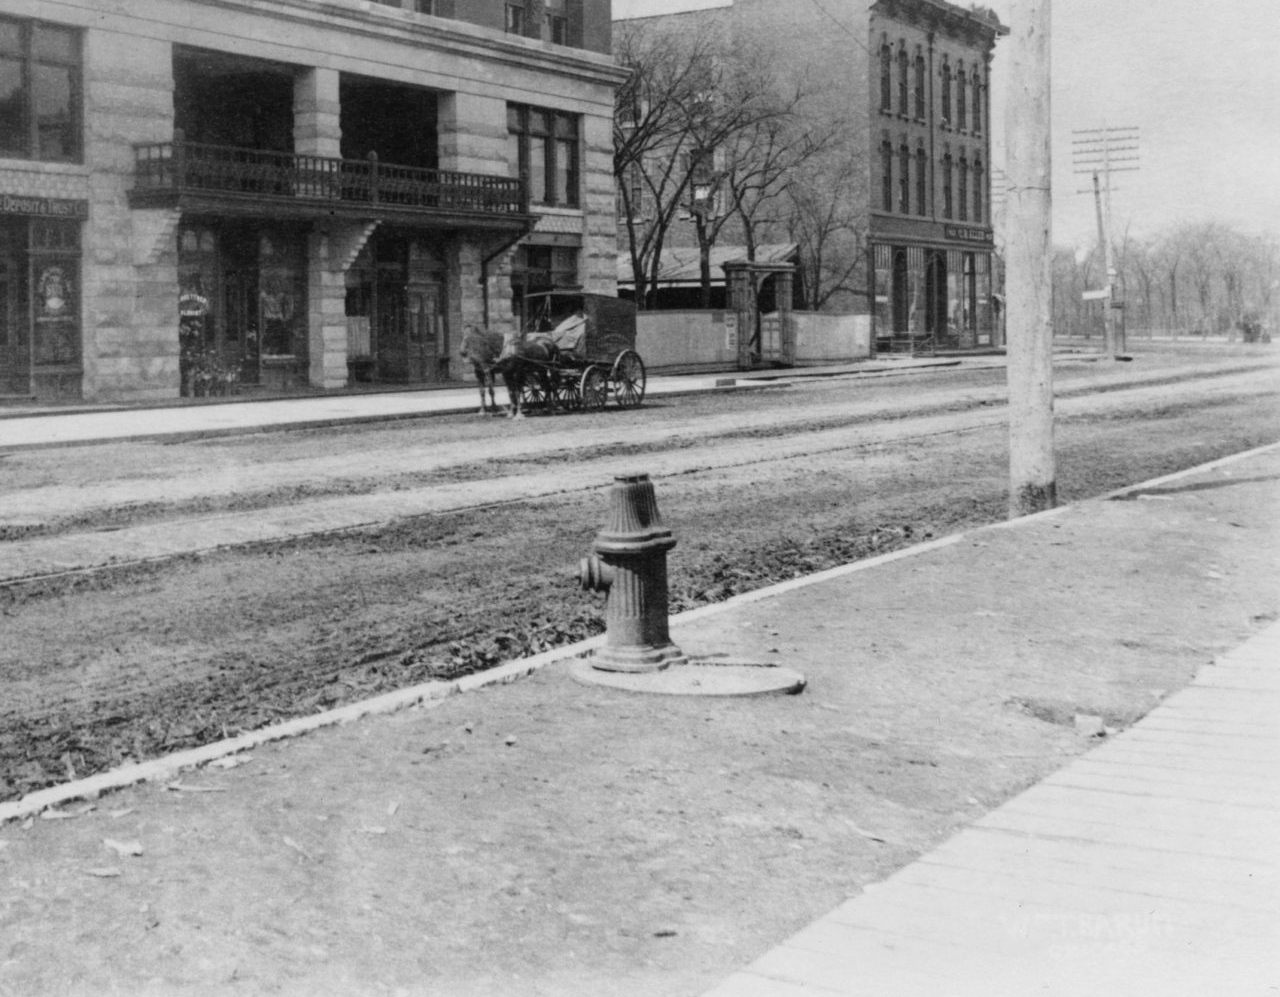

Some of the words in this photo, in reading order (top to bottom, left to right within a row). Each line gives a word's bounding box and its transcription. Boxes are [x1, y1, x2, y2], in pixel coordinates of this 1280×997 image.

[4, 195, 38, 213] DEPOSIT
[40, 203, 47, 214] &
[48, 199, 73, 215] TRUST
